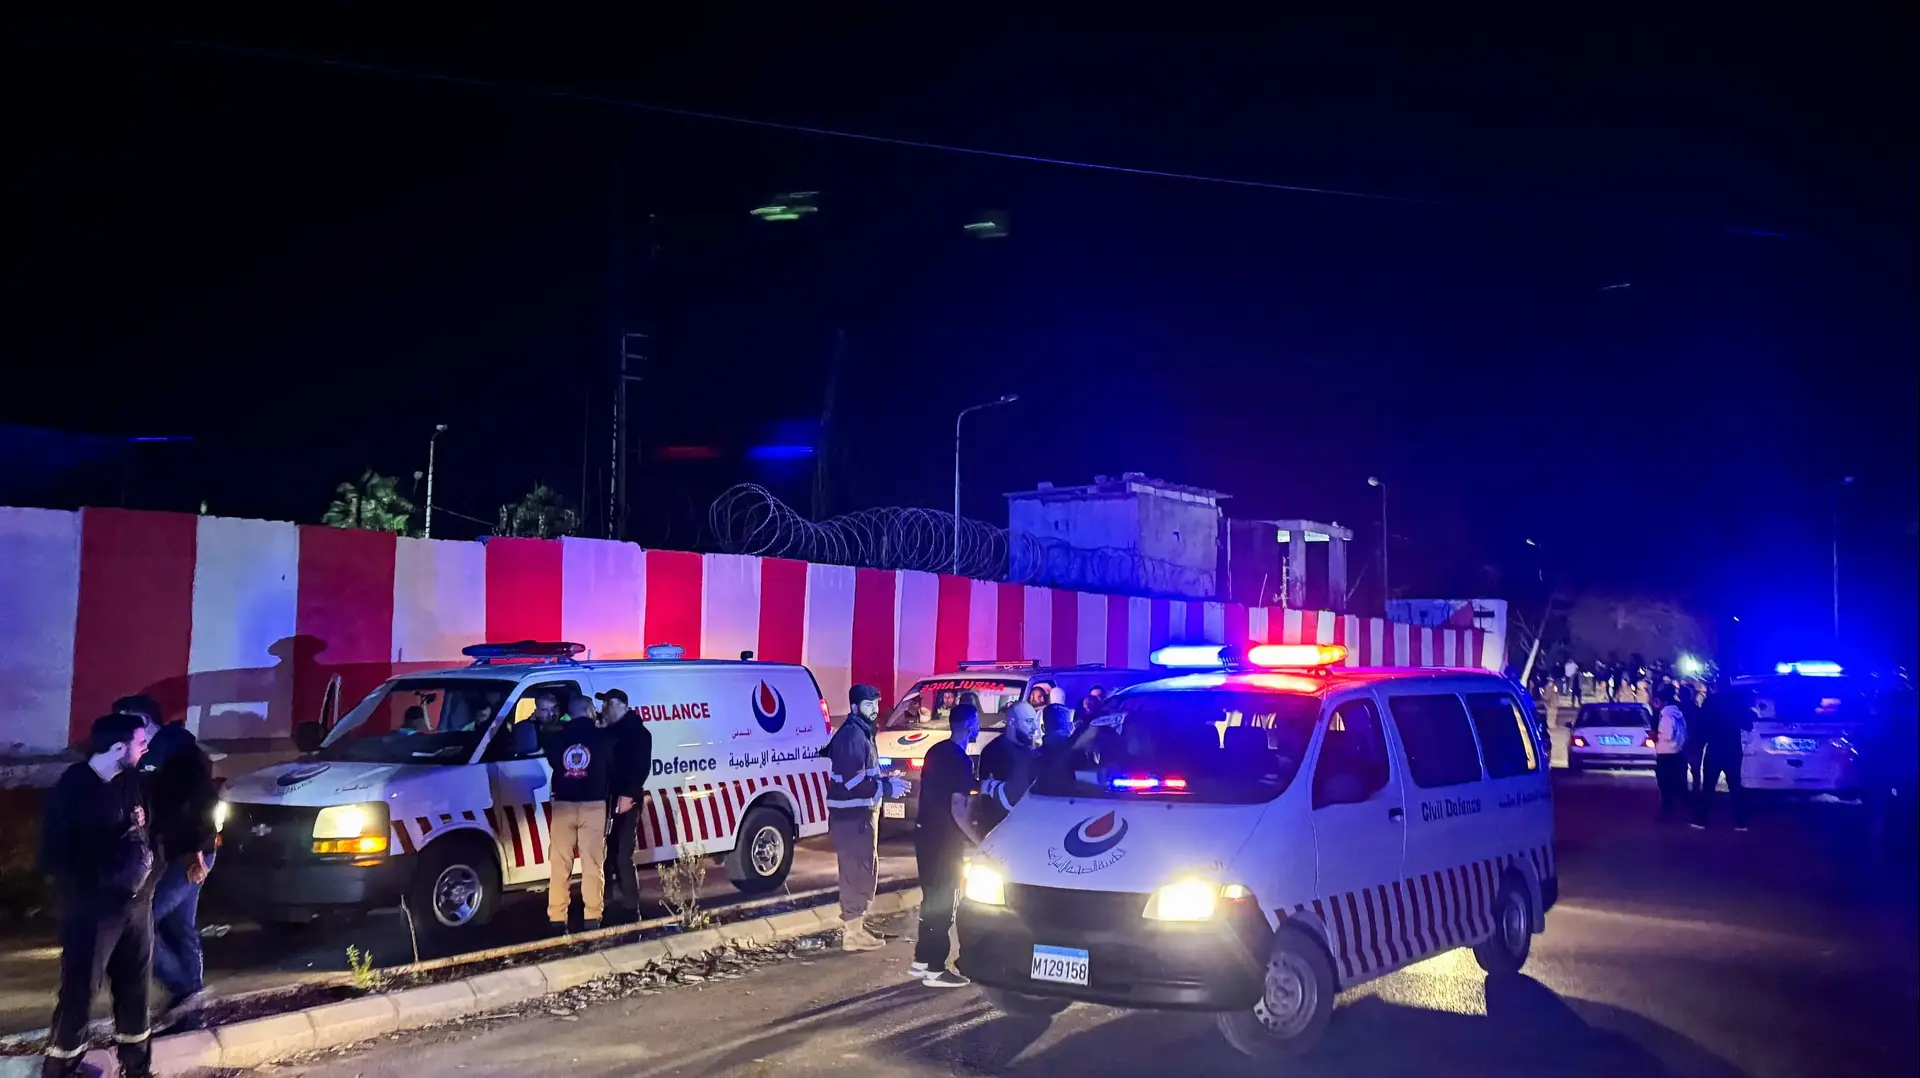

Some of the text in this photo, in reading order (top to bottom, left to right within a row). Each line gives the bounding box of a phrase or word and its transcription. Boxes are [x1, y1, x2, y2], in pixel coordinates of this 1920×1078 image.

[634, 702, 711, 722] BULANCE
[652, 756, 716, 776] Defence
[771, 747, 800, 765] الصحية
[1421, 799, 1443, 822] Civil
[1444, 797, 1481, 817] Defence
[1032, 957, 1087, 981] M129158
